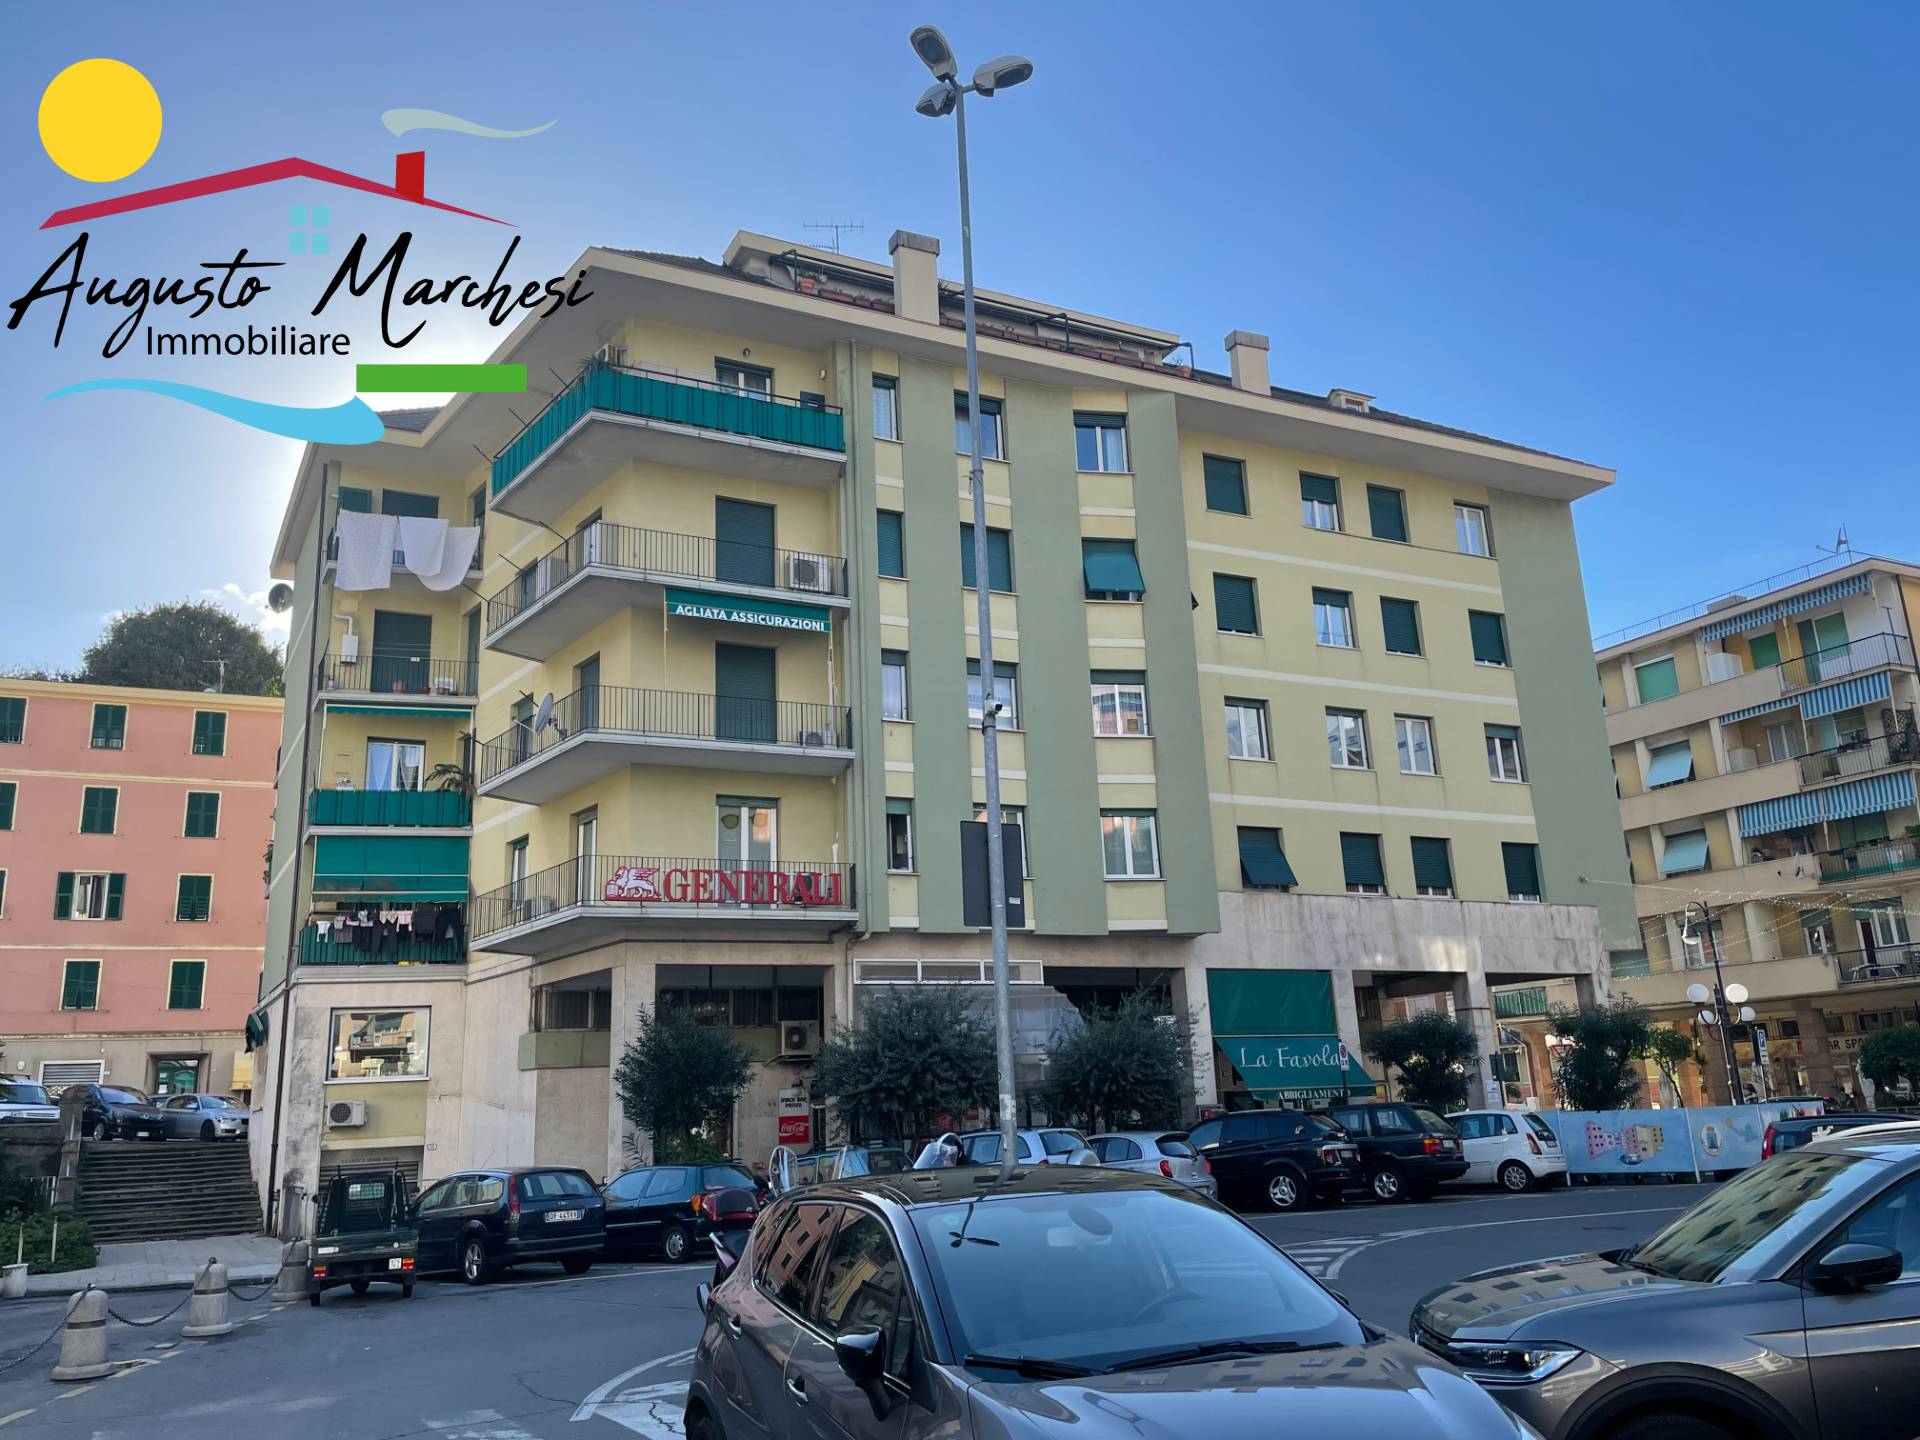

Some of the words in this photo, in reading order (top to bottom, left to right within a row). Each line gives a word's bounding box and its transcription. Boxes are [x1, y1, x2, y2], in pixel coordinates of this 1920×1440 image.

[675, 605, 729, 621] AGLIATA
[730, 611, 825, 632] ASSICURAZIONI
[663, 868, 842, 905] GENERALI
[1240, 1047, 1272, 1068] La
[1275, 1044, 1341, 1068] Favola
